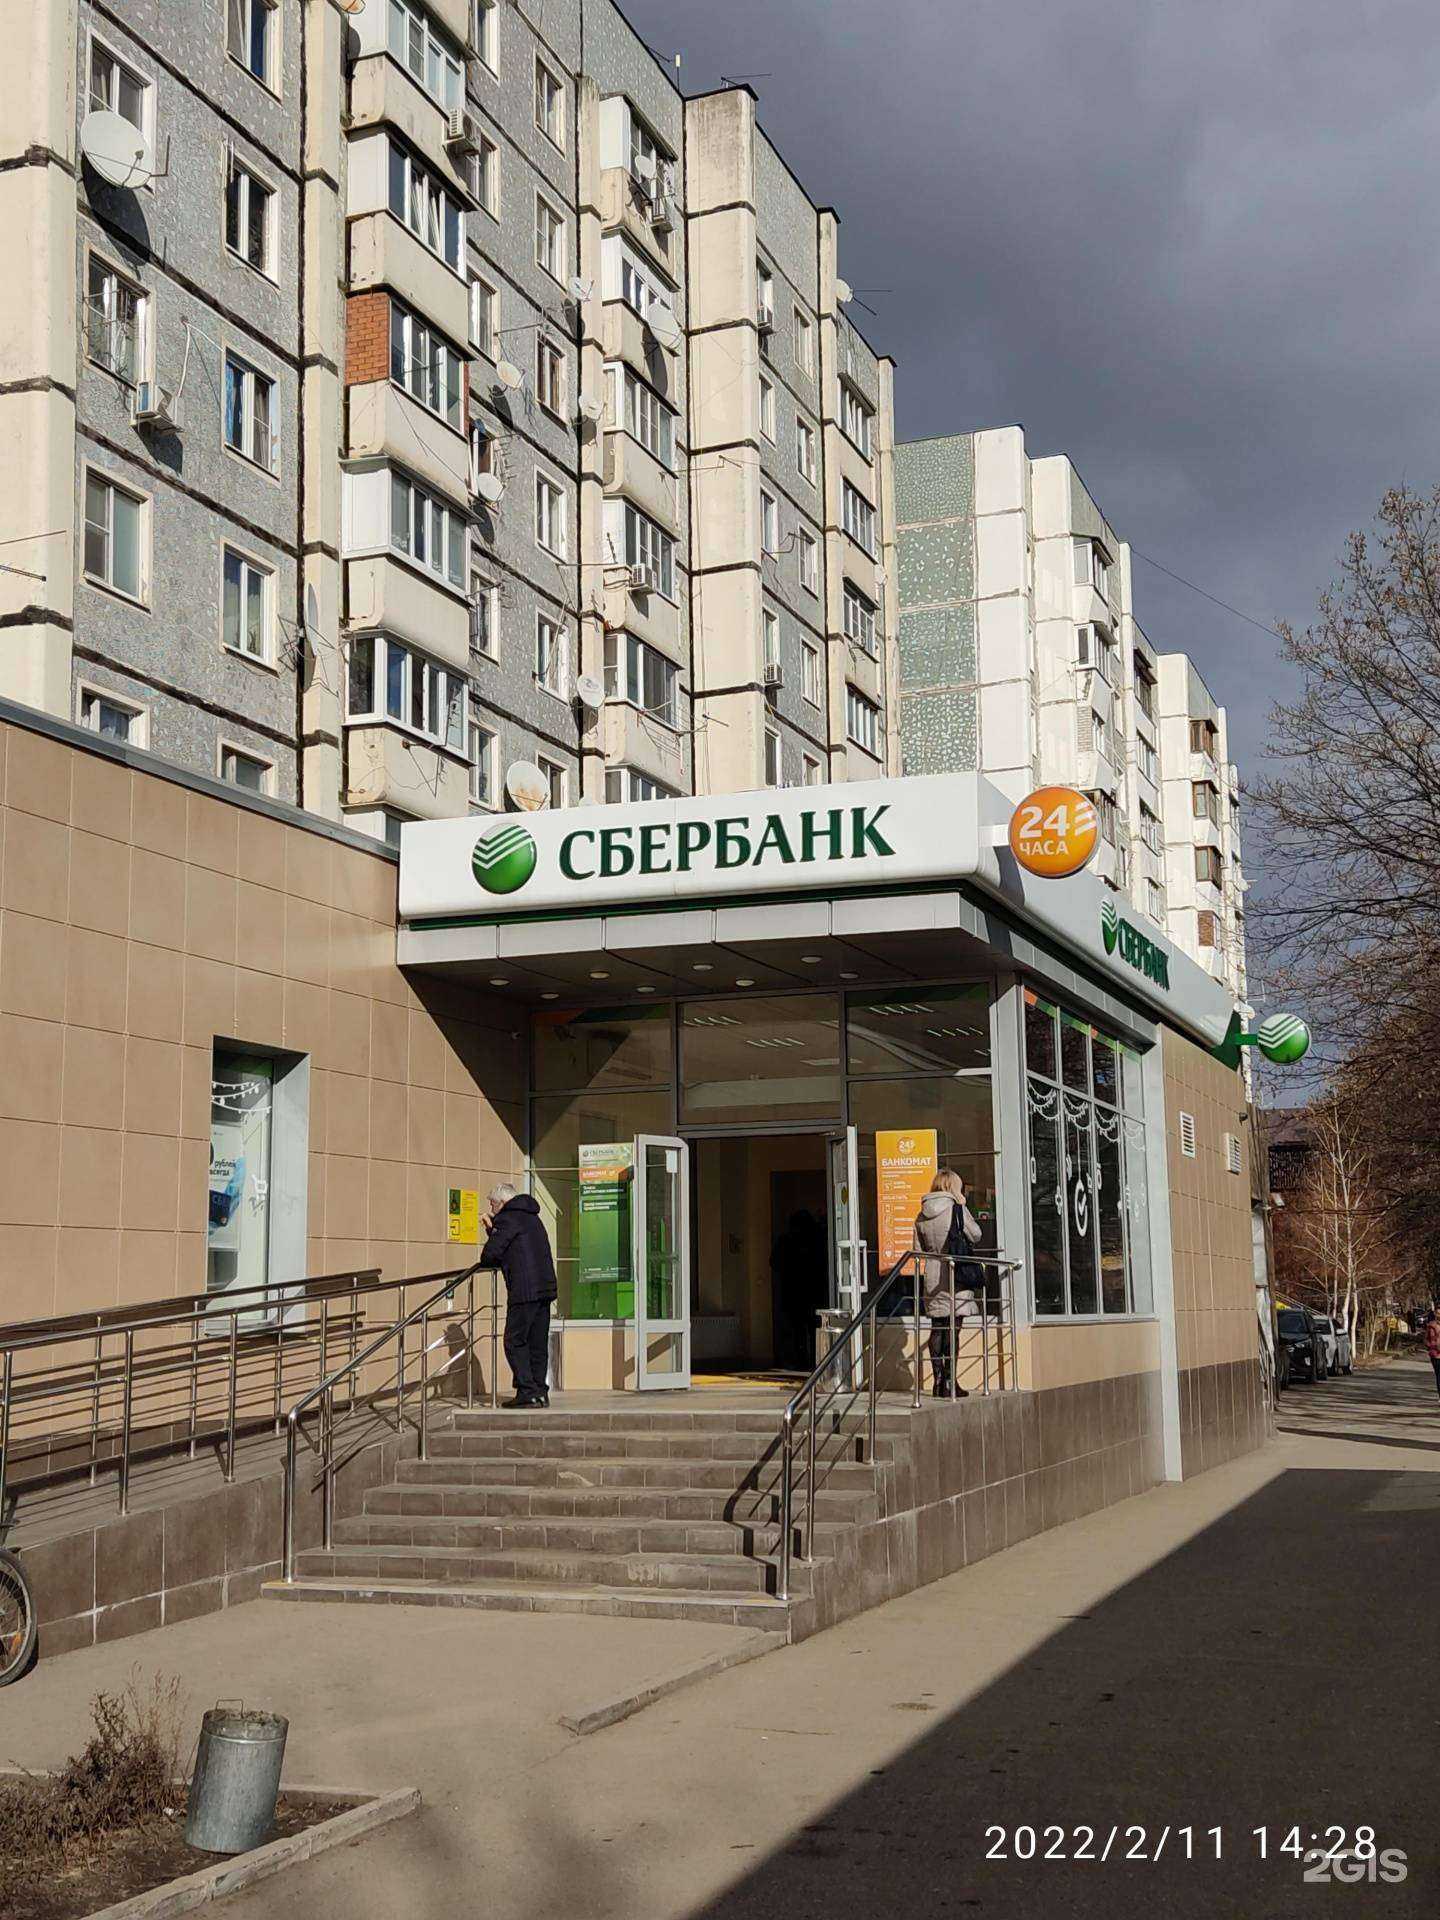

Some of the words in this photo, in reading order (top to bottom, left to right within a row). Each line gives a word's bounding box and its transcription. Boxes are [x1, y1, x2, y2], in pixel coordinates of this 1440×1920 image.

[1019, 804, 1070, 839] 24
[559, 805, 896, 880] СБЕРБАНК
[1019, 840, 1070, 857] ЧАСА
[881, 1157, 931, 1167] БАНКОМАТ
